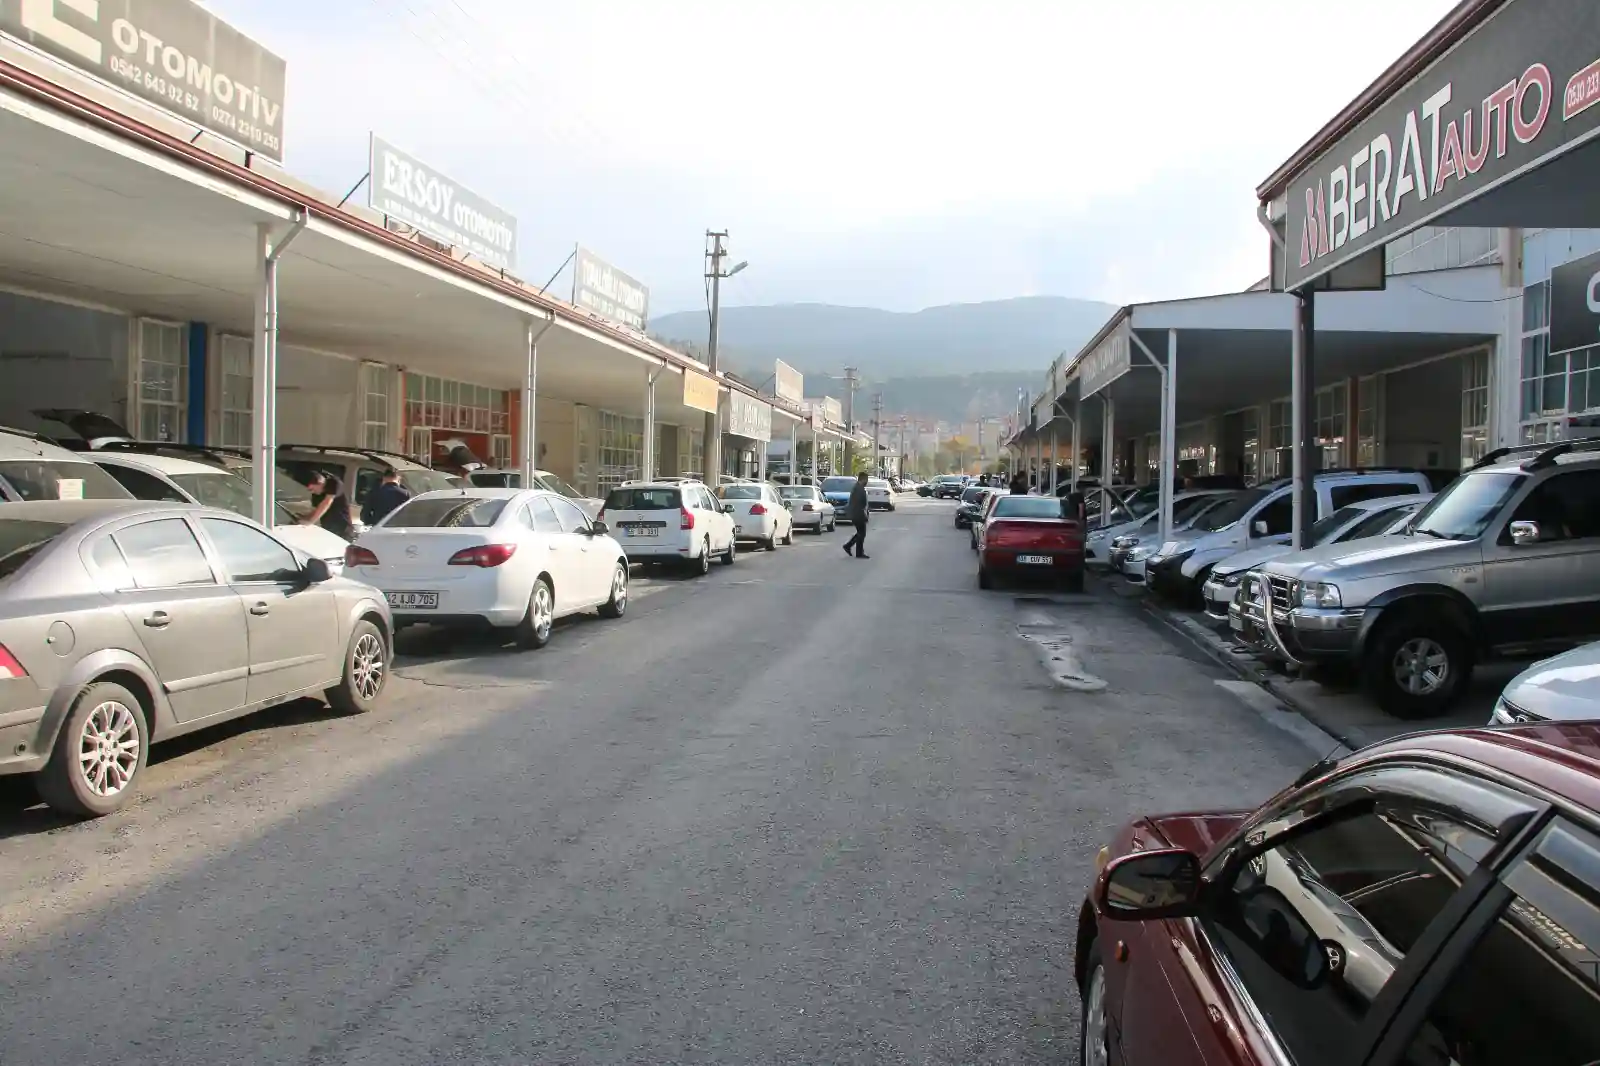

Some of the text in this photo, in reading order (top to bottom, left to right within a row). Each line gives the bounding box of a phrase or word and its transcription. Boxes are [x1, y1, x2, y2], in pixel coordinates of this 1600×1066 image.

[110, 55, 142, 84] 0542
[144, 71, 166, 95] 643
[168, 83, 183, 104] 02
[111, 18, 281, 127] OTOMOTİV
[382, 150, 454, 221] ERSOY
[1330, 62, 1552, 251] BERAT AUTO
[418, 594, 435, 605] 705
